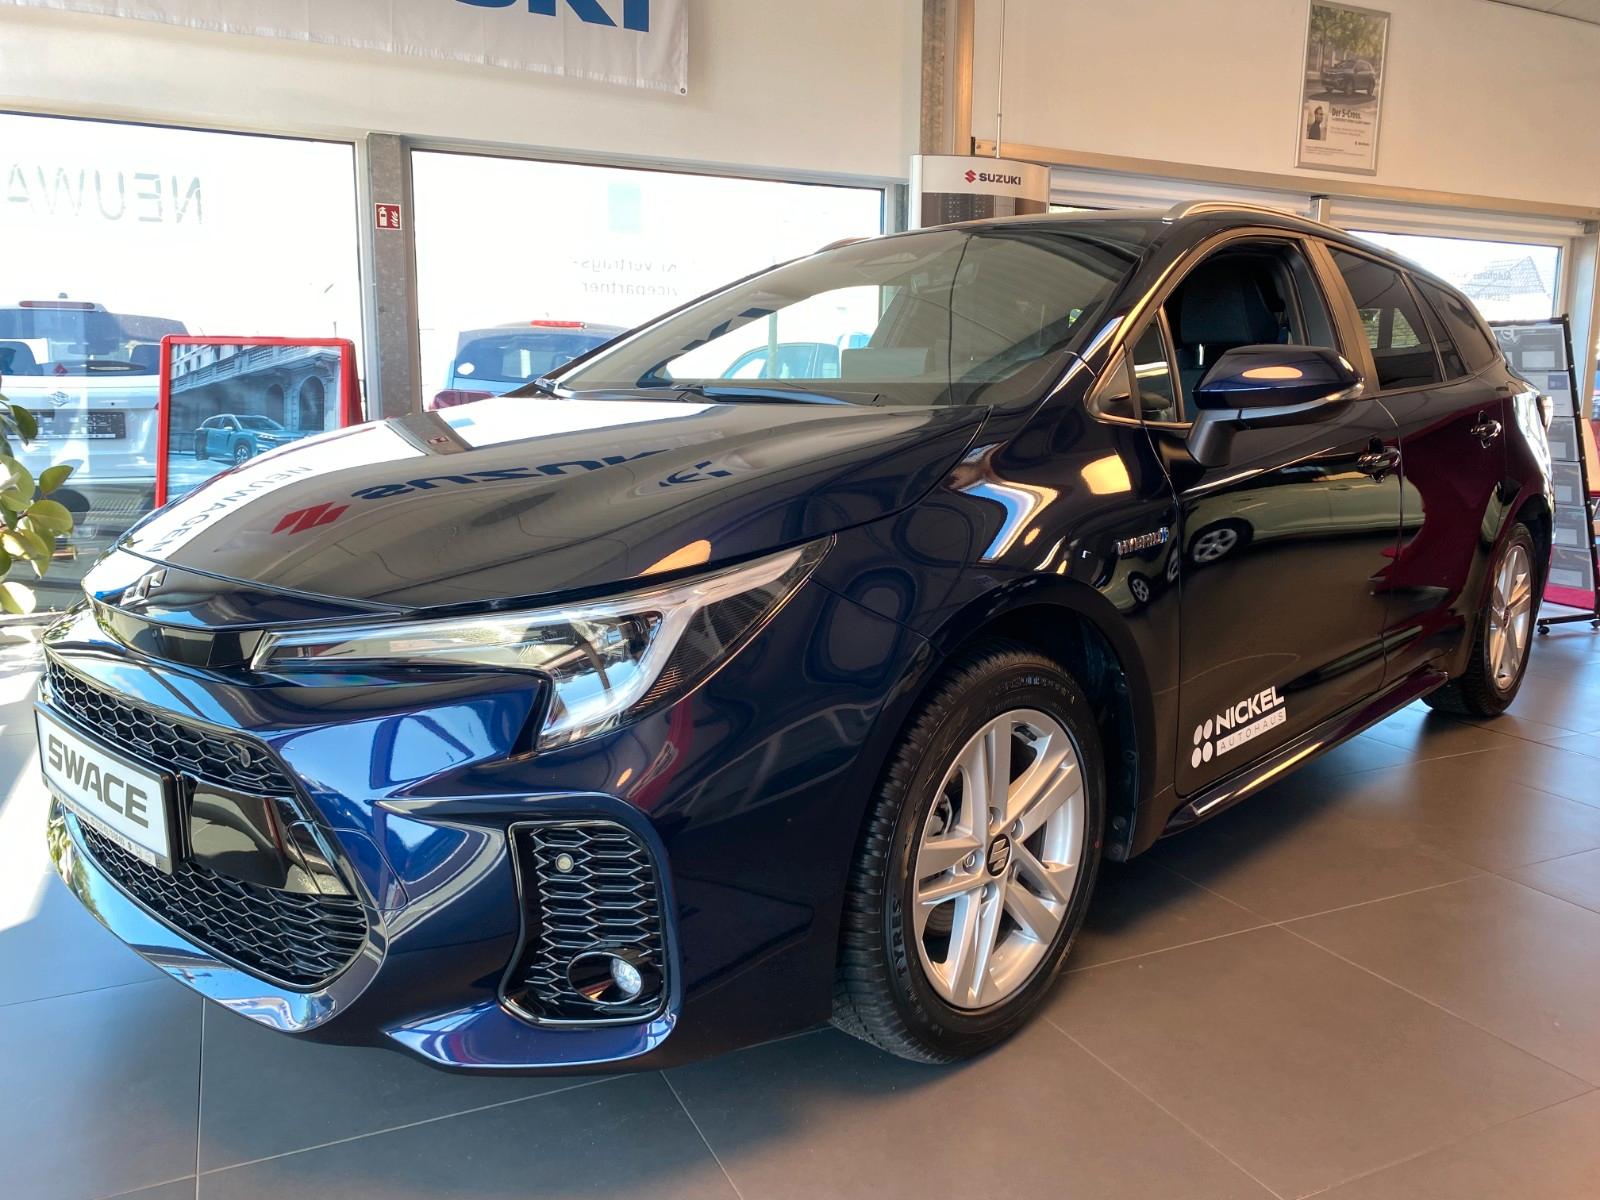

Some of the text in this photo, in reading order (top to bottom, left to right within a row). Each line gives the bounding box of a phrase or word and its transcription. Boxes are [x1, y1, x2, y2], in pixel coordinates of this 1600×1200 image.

[978, 173, 1022, 185] SUZUKI
[1216, 686, 1285, 735] NICKEL
[1219, 709, 1286, 752] AUTOHAUS
[48, 732, 150, 829] SWACE
